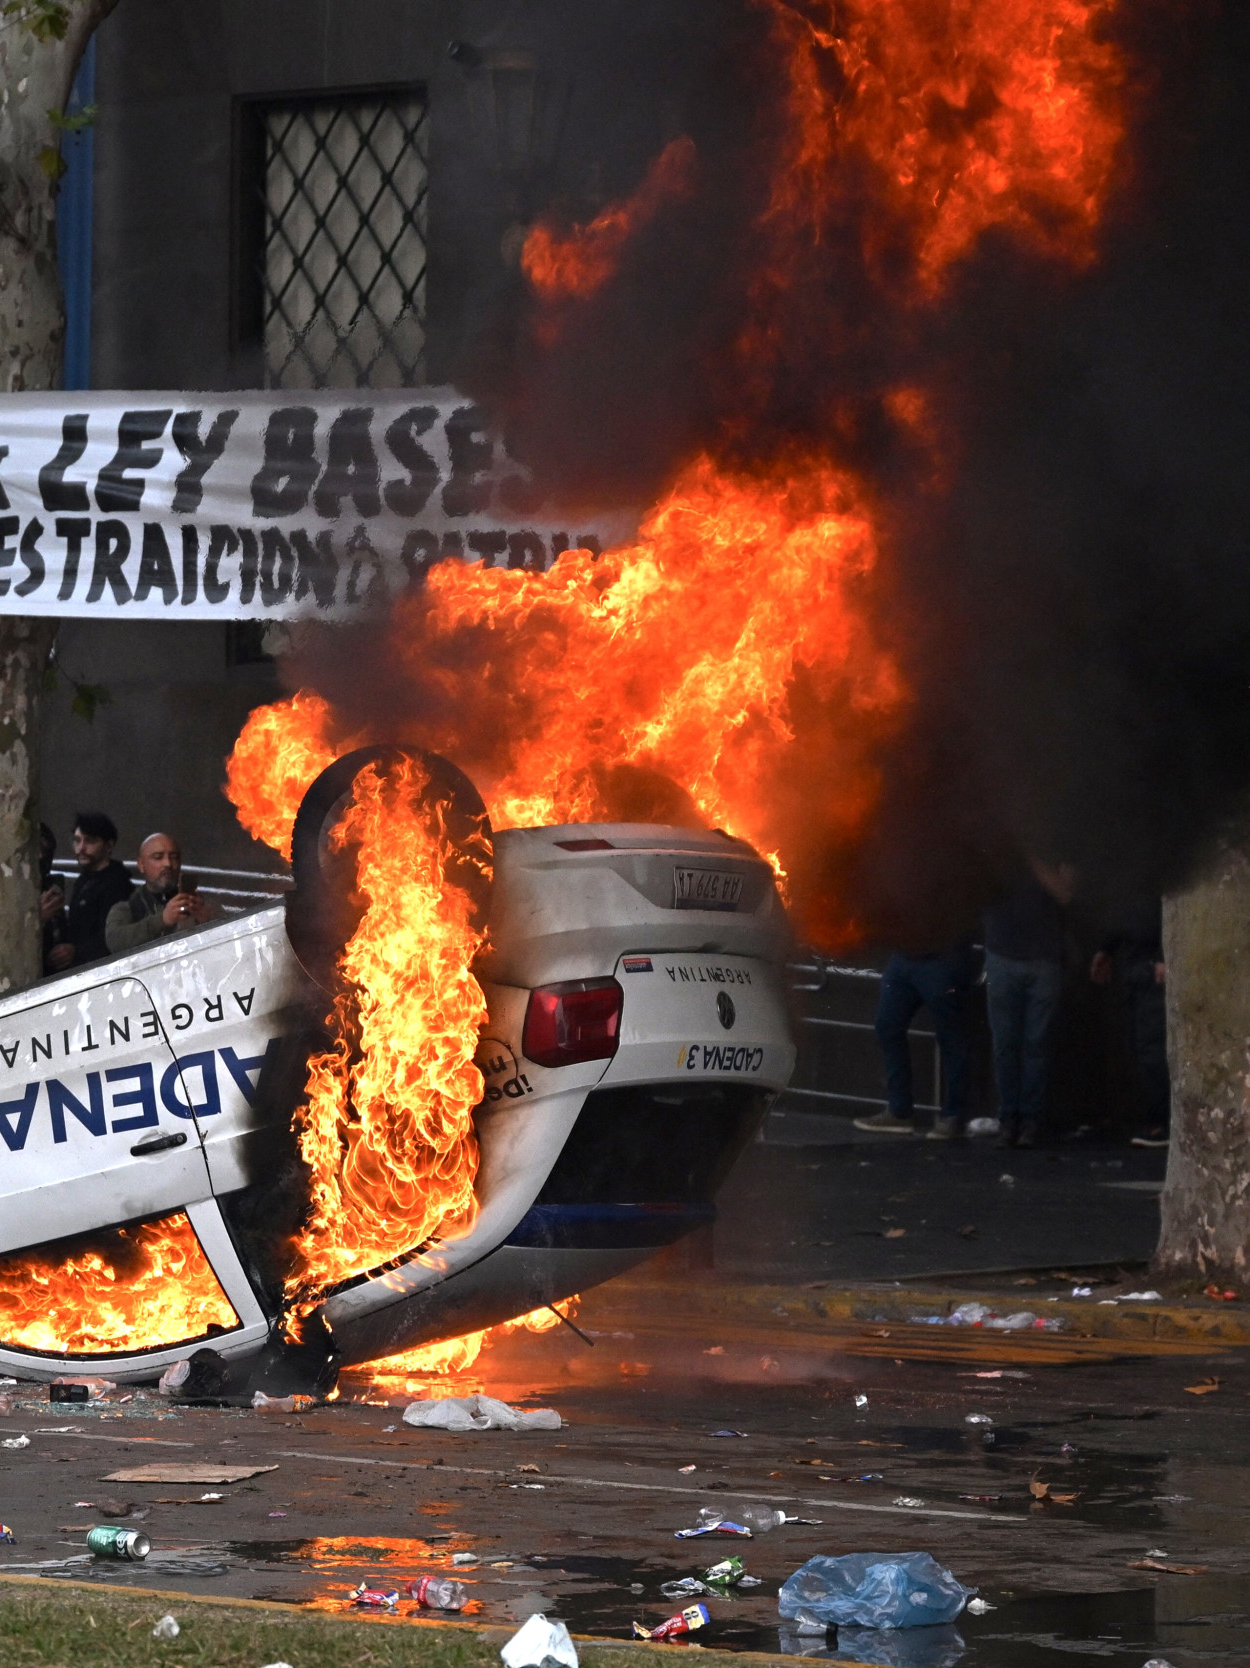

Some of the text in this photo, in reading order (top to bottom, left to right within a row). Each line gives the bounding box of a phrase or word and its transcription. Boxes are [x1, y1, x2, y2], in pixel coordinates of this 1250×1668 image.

[38, 409, 240, 513] LEY
[55, 516, 338, 609] TRAICION
[664, 966, 753, 986] ARGENTINA
[686, 1044, 764, 1072] CADENA 3
